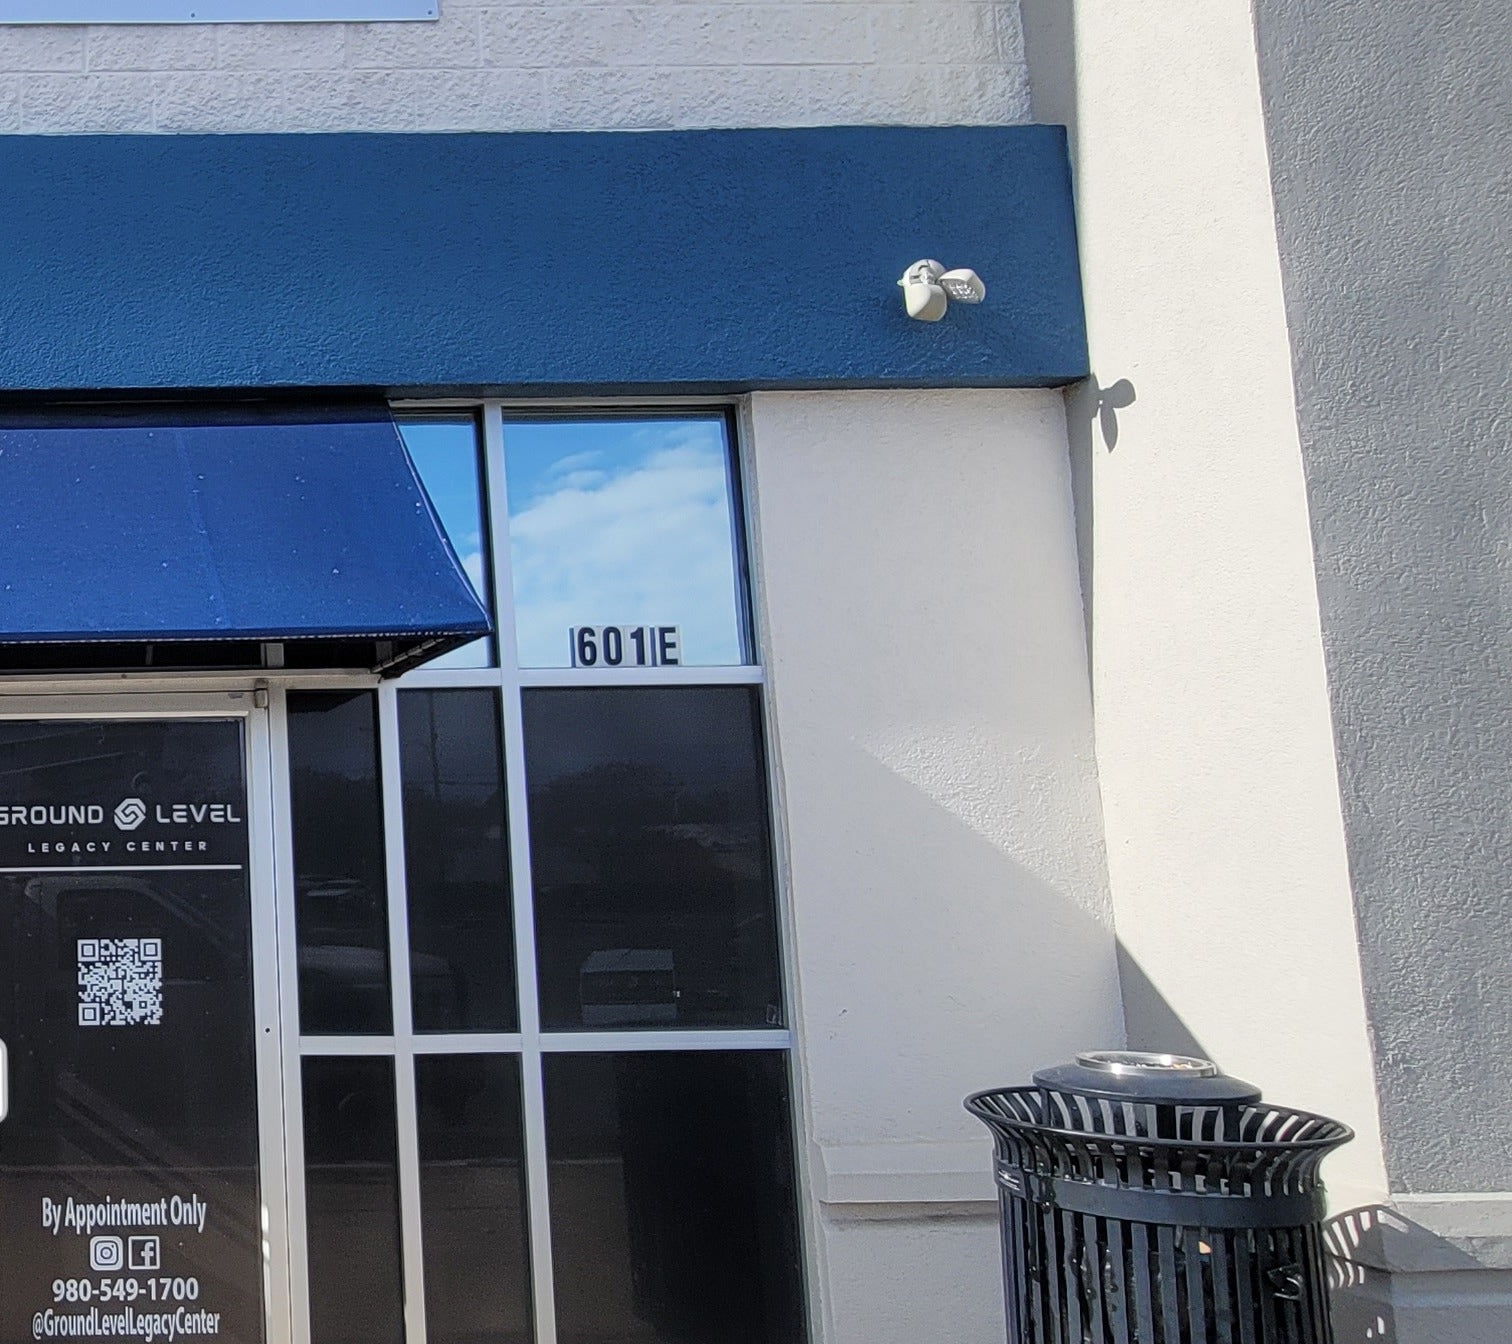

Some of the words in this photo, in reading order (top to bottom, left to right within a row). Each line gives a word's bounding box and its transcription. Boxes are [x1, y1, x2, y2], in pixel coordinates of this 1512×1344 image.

[577, 626, 679, 666] 601E
[155, 803, 241, 824] LEVEL
[27, 841, 111, 853] LEGACY
[126, 840, 208, 852] CENTER
[42, 1197, 62, 1236] By
[64, 1195, 168, 1234] Appointment
[170, 1193, 207, 1234] Only
[52, 1276, 199, 1303] 980-549-1700
[32, 1306, 221, 1343] @GroundLevelLegacyCenter
